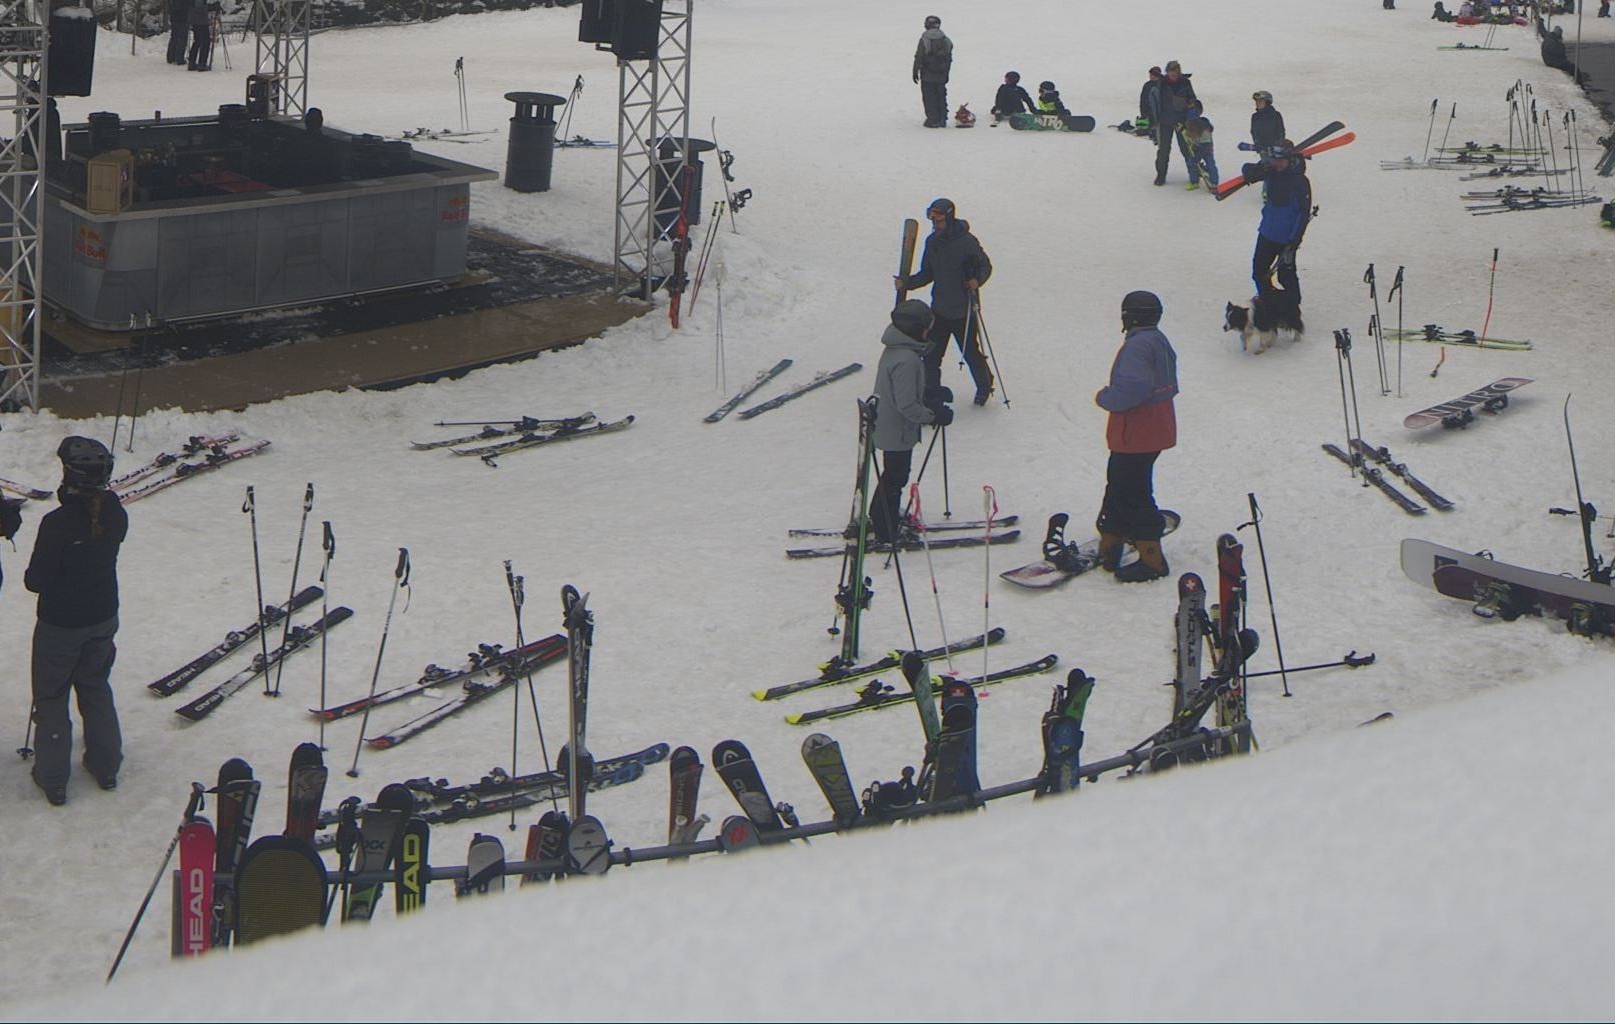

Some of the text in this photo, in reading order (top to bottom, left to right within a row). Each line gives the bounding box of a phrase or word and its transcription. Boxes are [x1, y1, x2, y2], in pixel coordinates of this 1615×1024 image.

[1415, 381, 1520, 419] NITRO
[166, 667, 197, 688] HEAD
[194, 692, 223, 712] HEAD
[403, 833, 420, 914] EAD
[190, 868, 204, 957] HEAD
